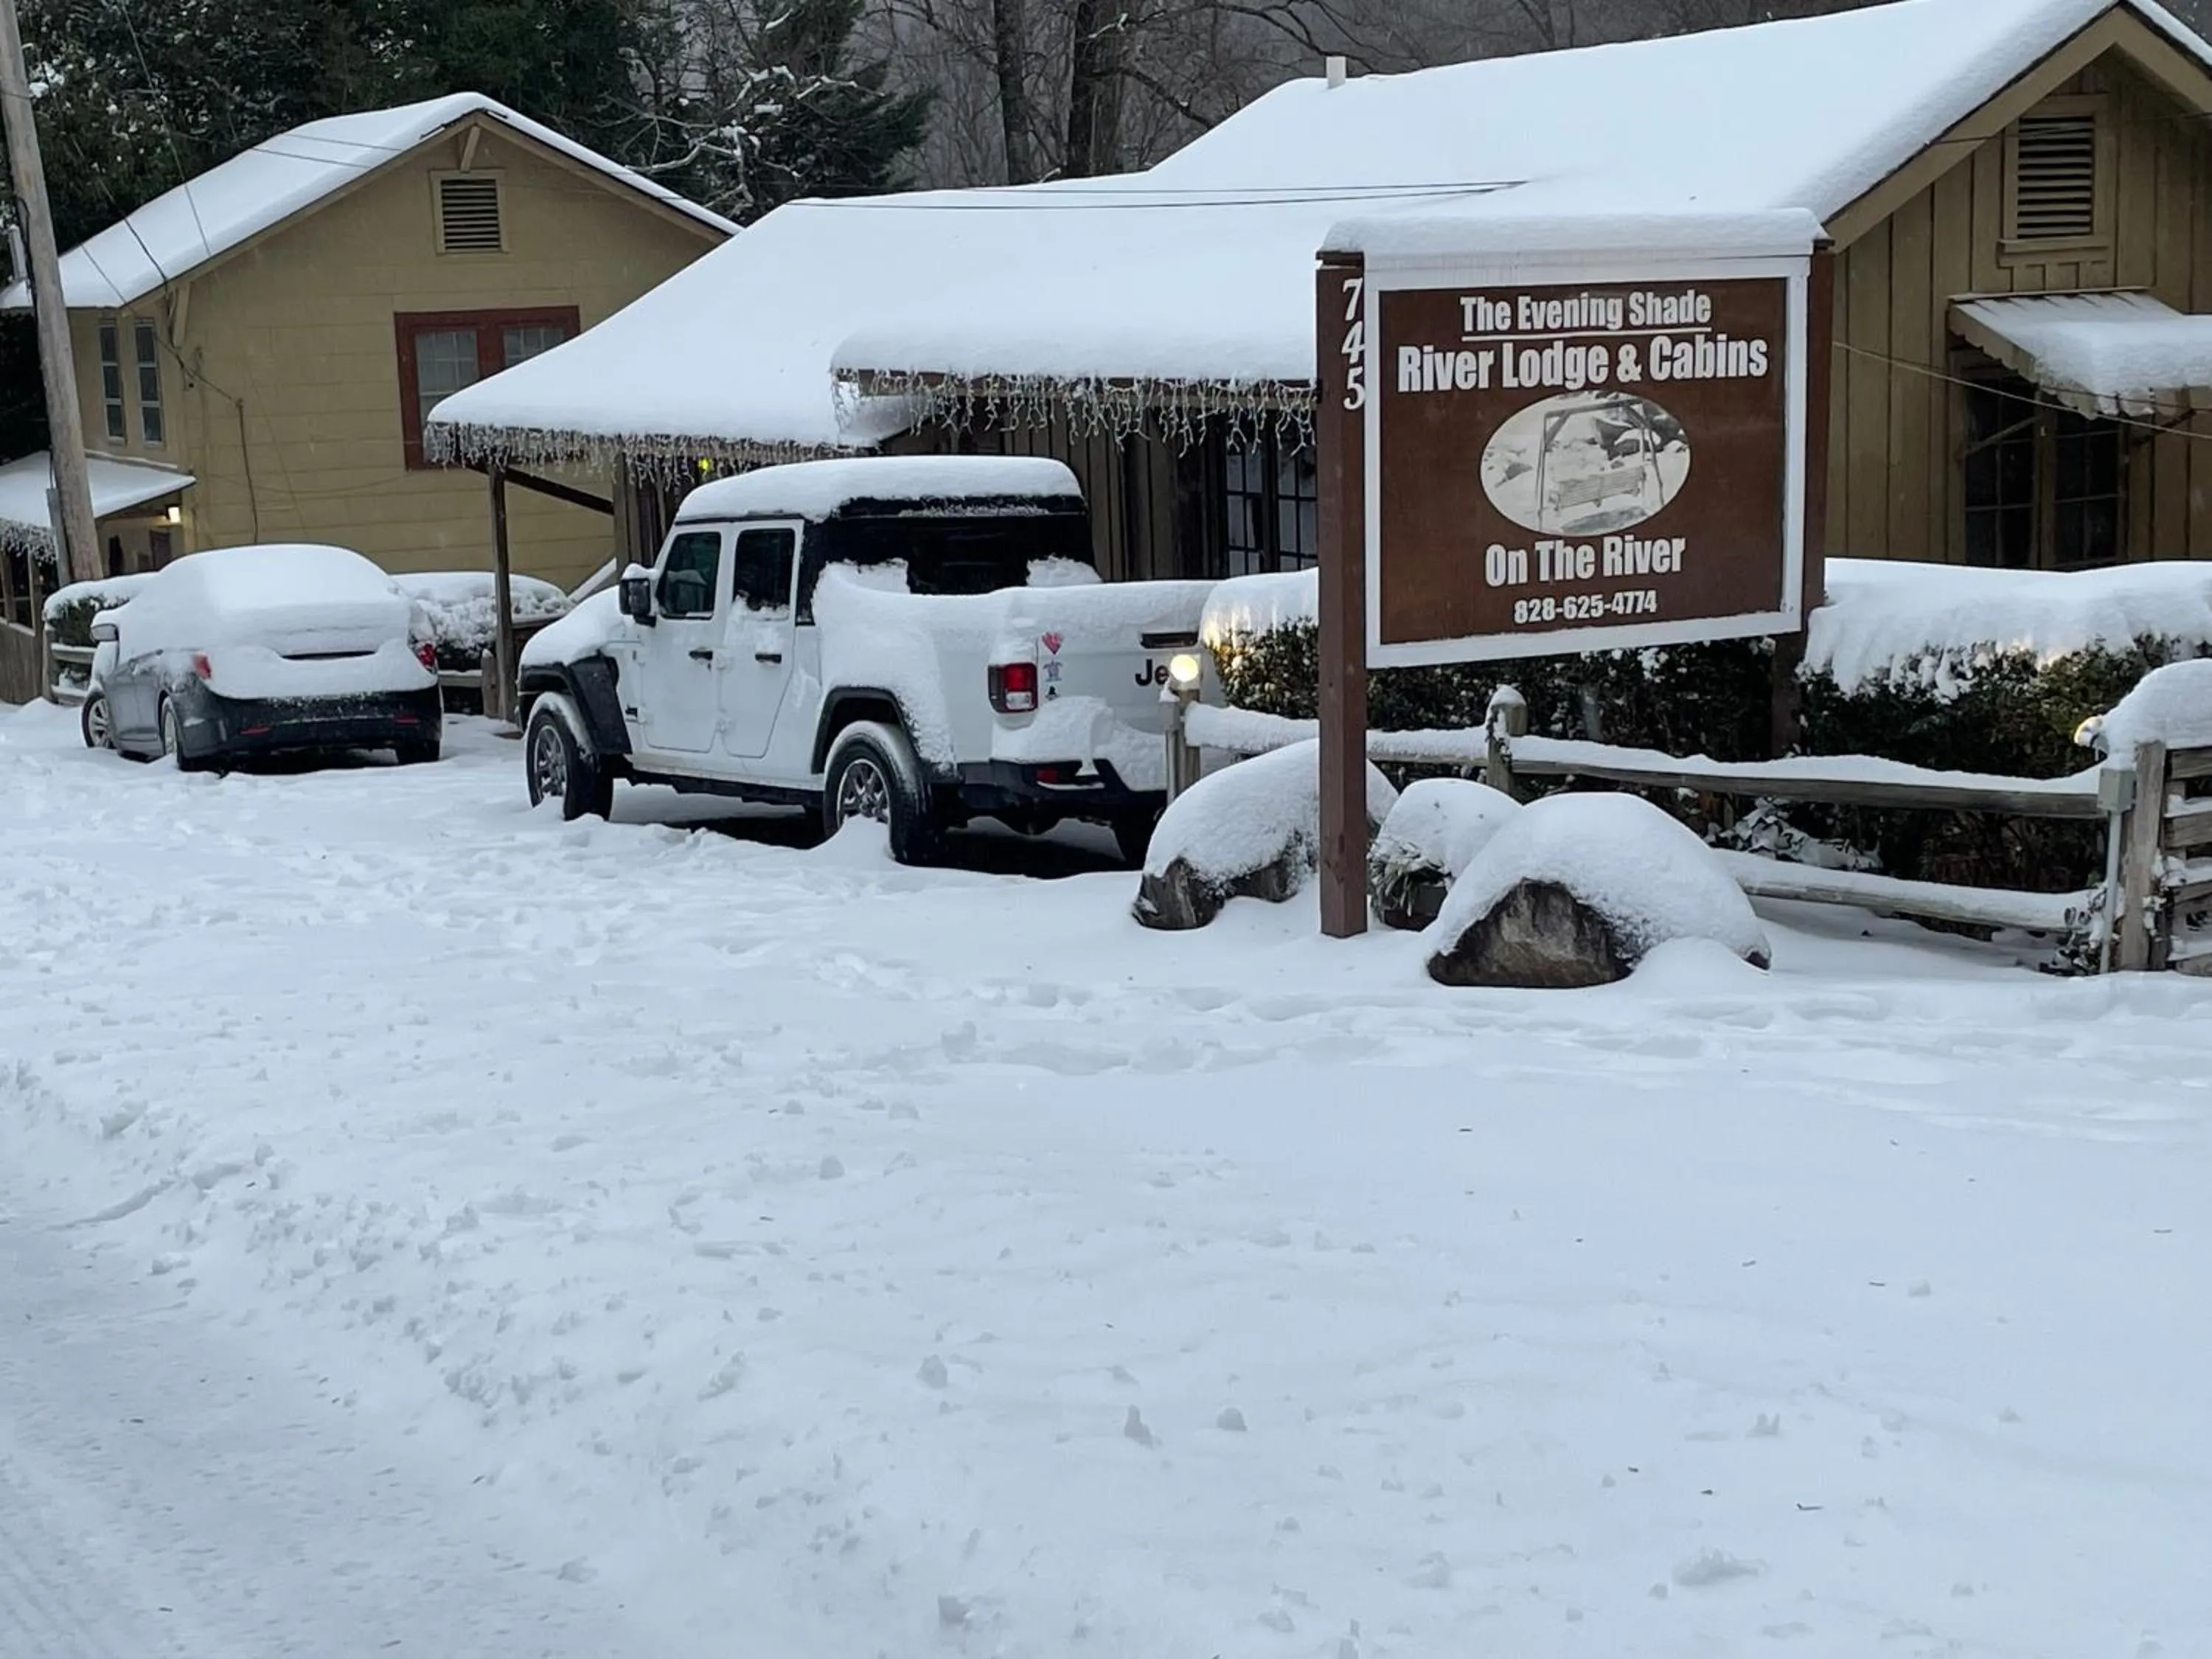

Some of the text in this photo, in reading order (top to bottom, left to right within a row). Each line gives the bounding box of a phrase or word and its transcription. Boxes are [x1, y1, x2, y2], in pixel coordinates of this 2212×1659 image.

[1461, 289, 1711, 332] The Evening Shade
[1341, 276, 1366, 410] 745
[1397, 334, 1768, 393] River Lodge & Cabins
[1485, 535, 1686, 588] On The River
[1514, 589, 1658, 625] 828-625-4774
